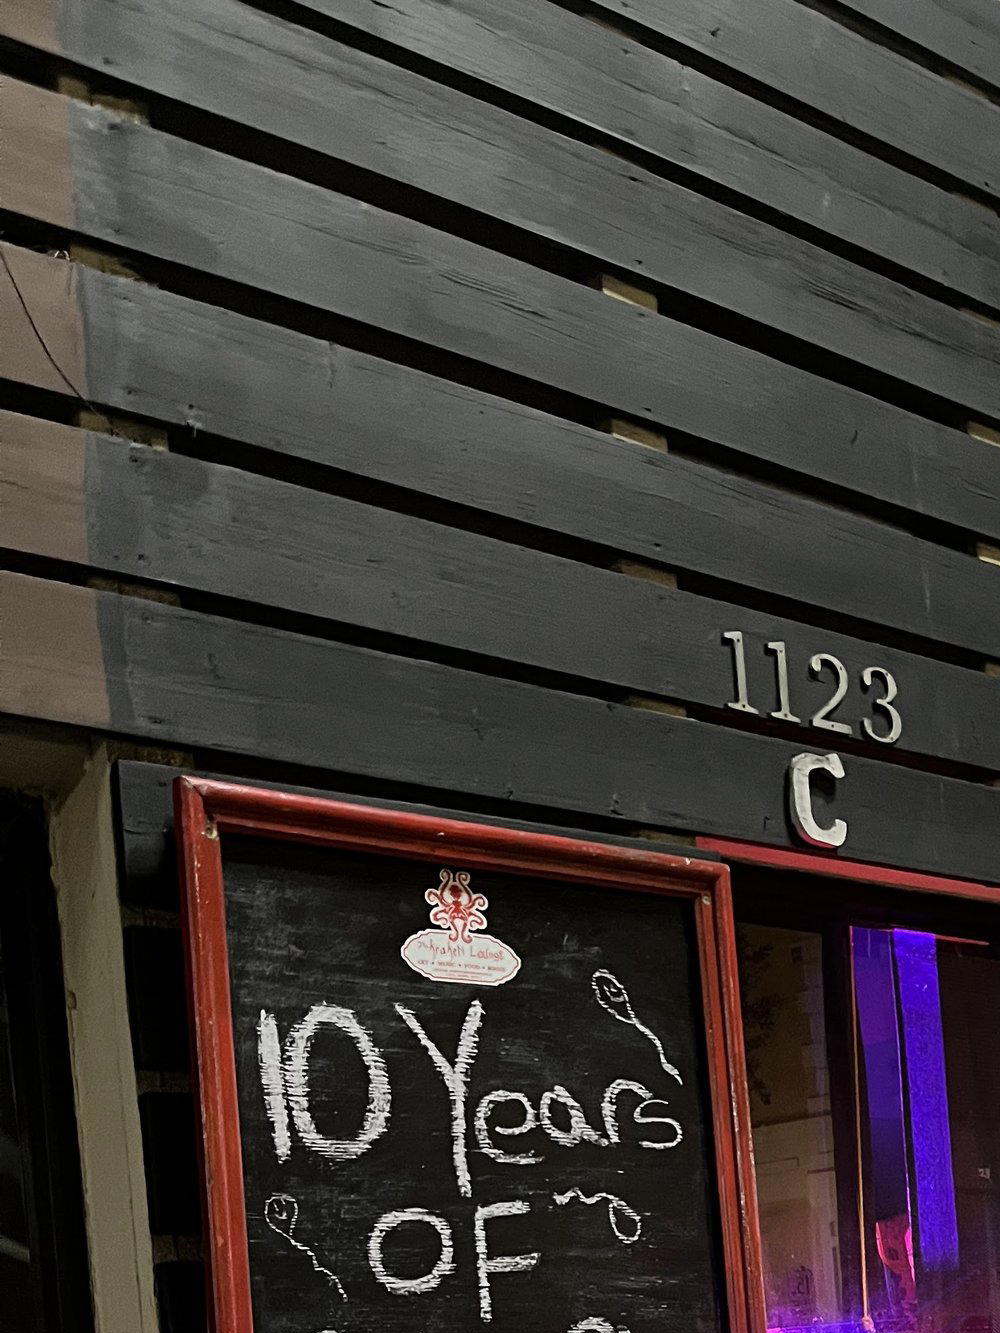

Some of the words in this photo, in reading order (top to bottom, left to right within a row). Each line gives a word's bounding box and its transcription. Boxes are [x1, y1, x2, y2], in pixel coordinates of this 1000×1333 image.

[722, 630, 902, 744] 1123
[790, 752, 848, 848] C
[257, 1001, 392, 1165] 10
[395, 999, 683, 1198] Years
[367, 1200, 541, 1323] OF
